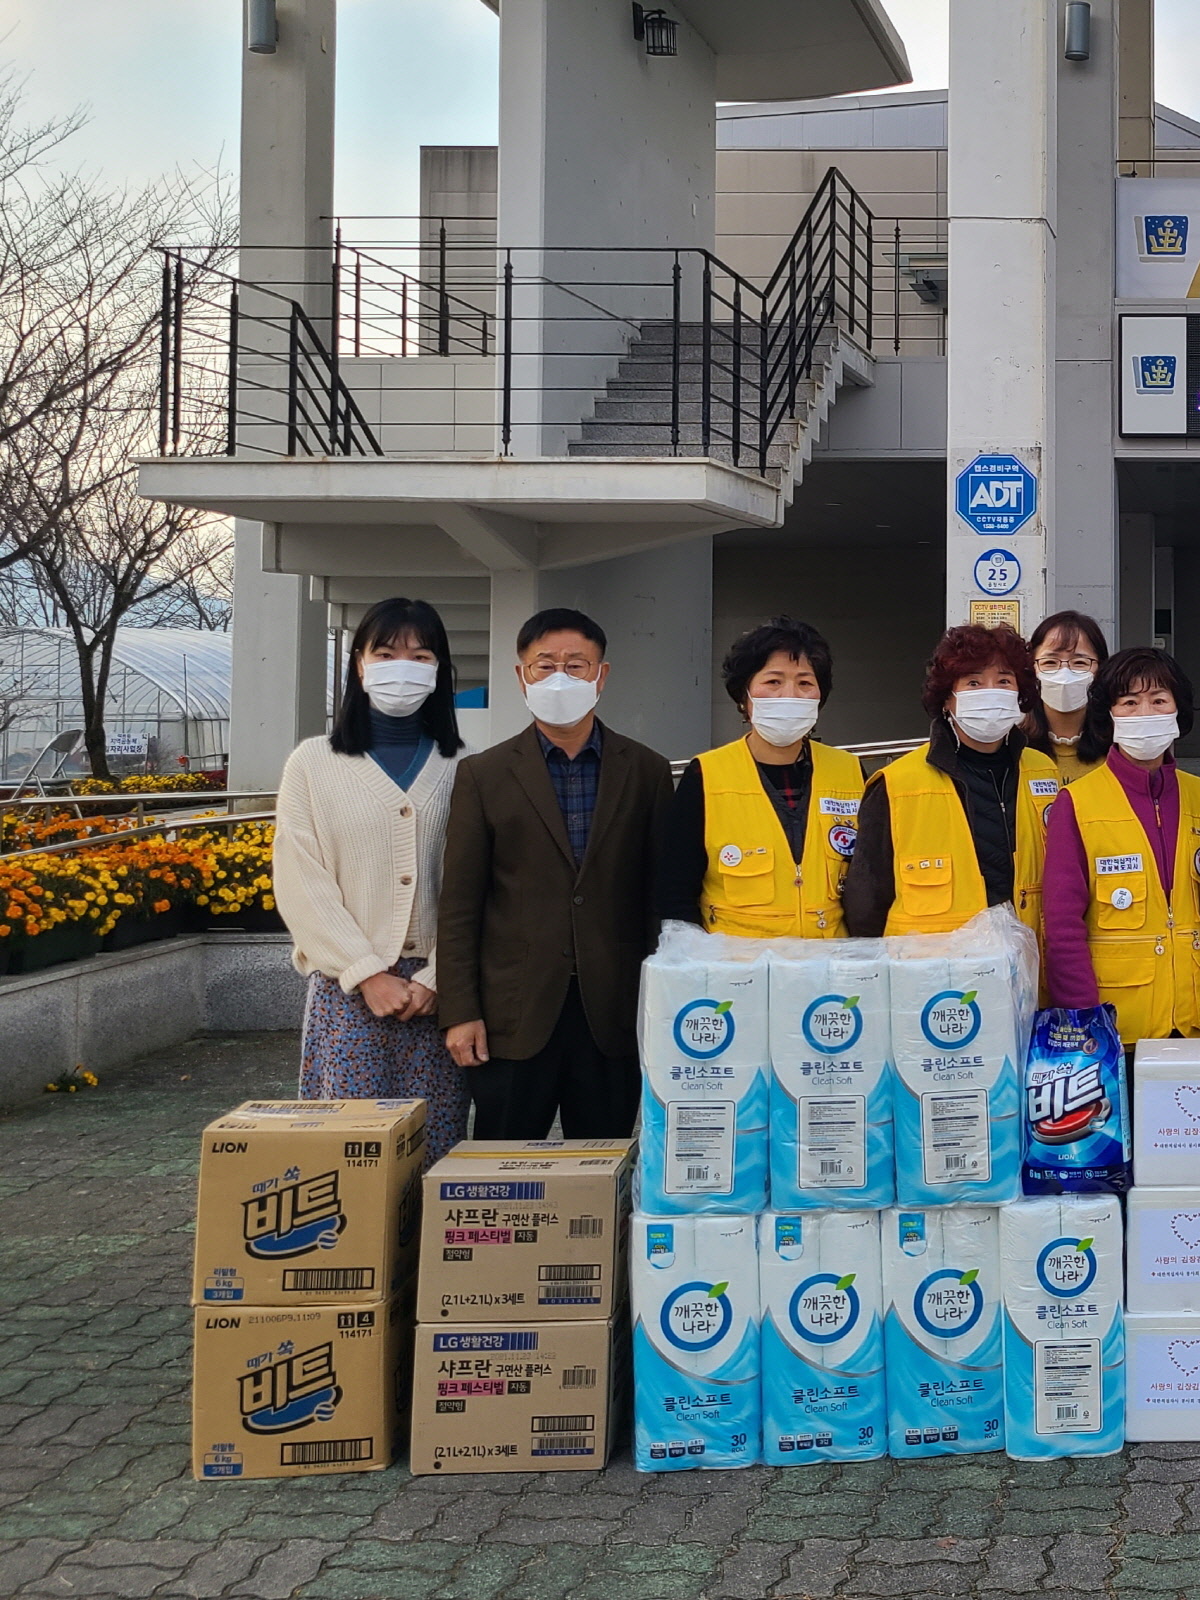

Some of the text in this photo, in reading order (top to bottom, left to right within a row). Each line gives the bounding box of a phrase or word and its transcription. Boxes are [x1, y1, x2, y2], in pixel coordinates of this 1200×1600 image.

[970, 481, 1023, 508] ADT
[988, 569, 1008, 581] 25
[932, 1008, 969, 1021] 깨끗한
[685, 1016, 723, 1031] 깨끗한
[939, 1023, 963, 1035] 나라
[692, 1032, 717, 1044] 나라
[921, 1056, 984, 1072] 클린소프트
[670, 1066, 734, 1080] 클린소프트
[933, 1071, 973, 1081] Clean Soft
[1027, 1062, 1104, 1122] 비트
[212, 1142, 248, 1153] LION
[369, 1143, 377, 1152] 4
[252, 1165, 301, 1193] 때가 쏙
[240, 1169, 341, 1240] 비트
[445, 1209, 559, 1227] 샤프란 구연산 플러스
[445, 1230, 534, 1243] 핑크 페스티벌 자동
[446, 1249, 470, 1259] 절약형
[1048, 1255, 1085, 1269] 깨끗한
[1055, 1270, 1079, 1282] 나라
[927, 1290, 970, 1305] 깨끗한
[362, 1313, 370, 1322] 4
[674, 1302, 719, 1320] 깨끗한
[935, 1307, 963, 1321] 나라
[1035, 1304, 1099, 1319] 클린소프트
[206, 1317, 241, 1329] LION
[682, 1320, 710, 1334] 나라
[339, 1329, 372, 1339] 114171
[247, 1339, 294, 1368] 때가 쏙
[438, 1360, 552, 1378] 샤프란 구연산 플러스
[236, 1341, 336, 1415] 비트
[438, 1382, 527, 1395] 핑크 페스티벌 자동
[917, 1379, 985, 1397] 클린소프트
[439, 1401, 463, 1410] 절약형
[662, 1394, 732, 1411] 클린소프트
[931, 1395, 973, 1407] Clean Soft
[676, 1410, 720, 1421] Clean Soft
[984, 1419, 999, 1432] 30
[731, 1433, 747, 1446] 30
